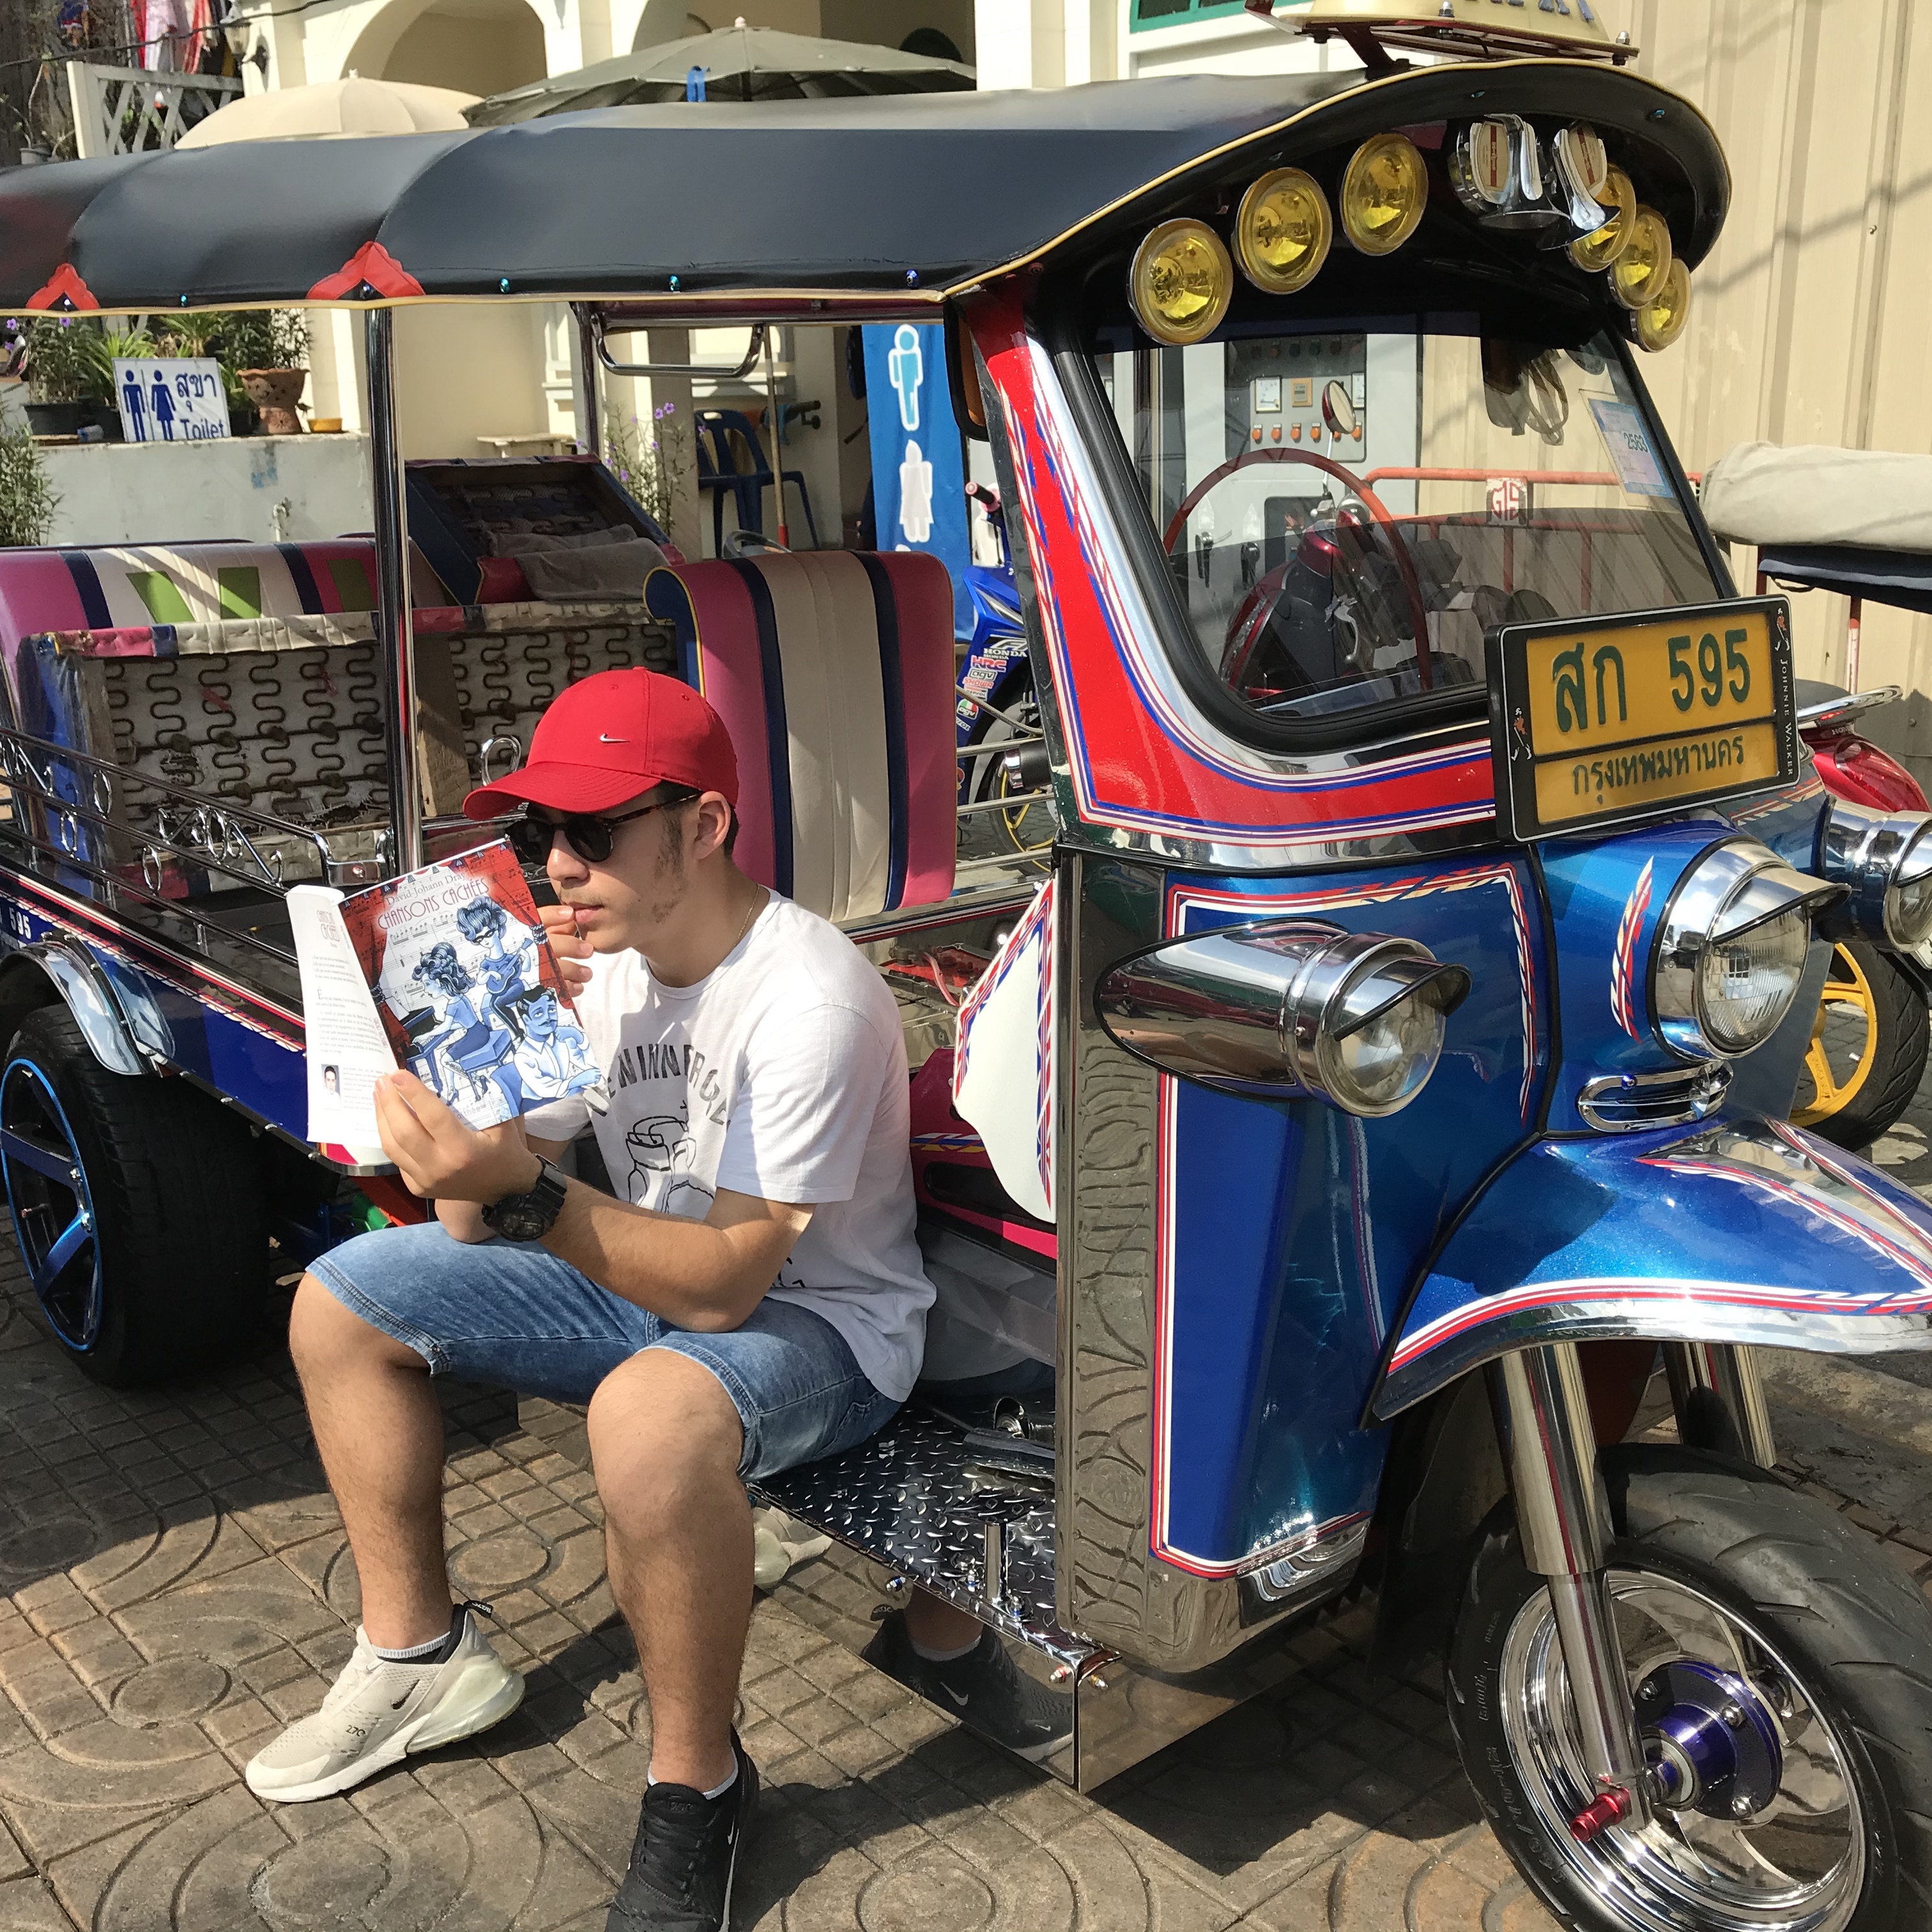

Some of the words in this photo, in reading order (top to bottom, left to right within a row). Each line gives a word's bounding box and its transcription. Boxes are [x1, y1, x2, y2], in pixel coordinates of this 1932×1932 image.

[175, 372, 217, 412] สุขา
[180, 418, 224, 440] Toilet
[1623, 432, 1648, 453] 2563
[971, 655, 1008, 673] HRC
[984, 648, 1027, 657] HONDA
[963, 678, 993, 689] SHOWA
[1551, 641, 1627, 733] สก
[1667, 628, 1751, 712] 595
[1780, 658, 1790, 717] JOHNNIE
[1785, 722, 1793, 776] WALKER
[1573, 735, 1745, 804] กรุงเทพมหานคร
[445, 872, 466, 884] Dray
[378, 895, 440, 930] CHANSONS
[442, 878, 489, 905] CACHÉES
[8, 907, 31, 940] 595
